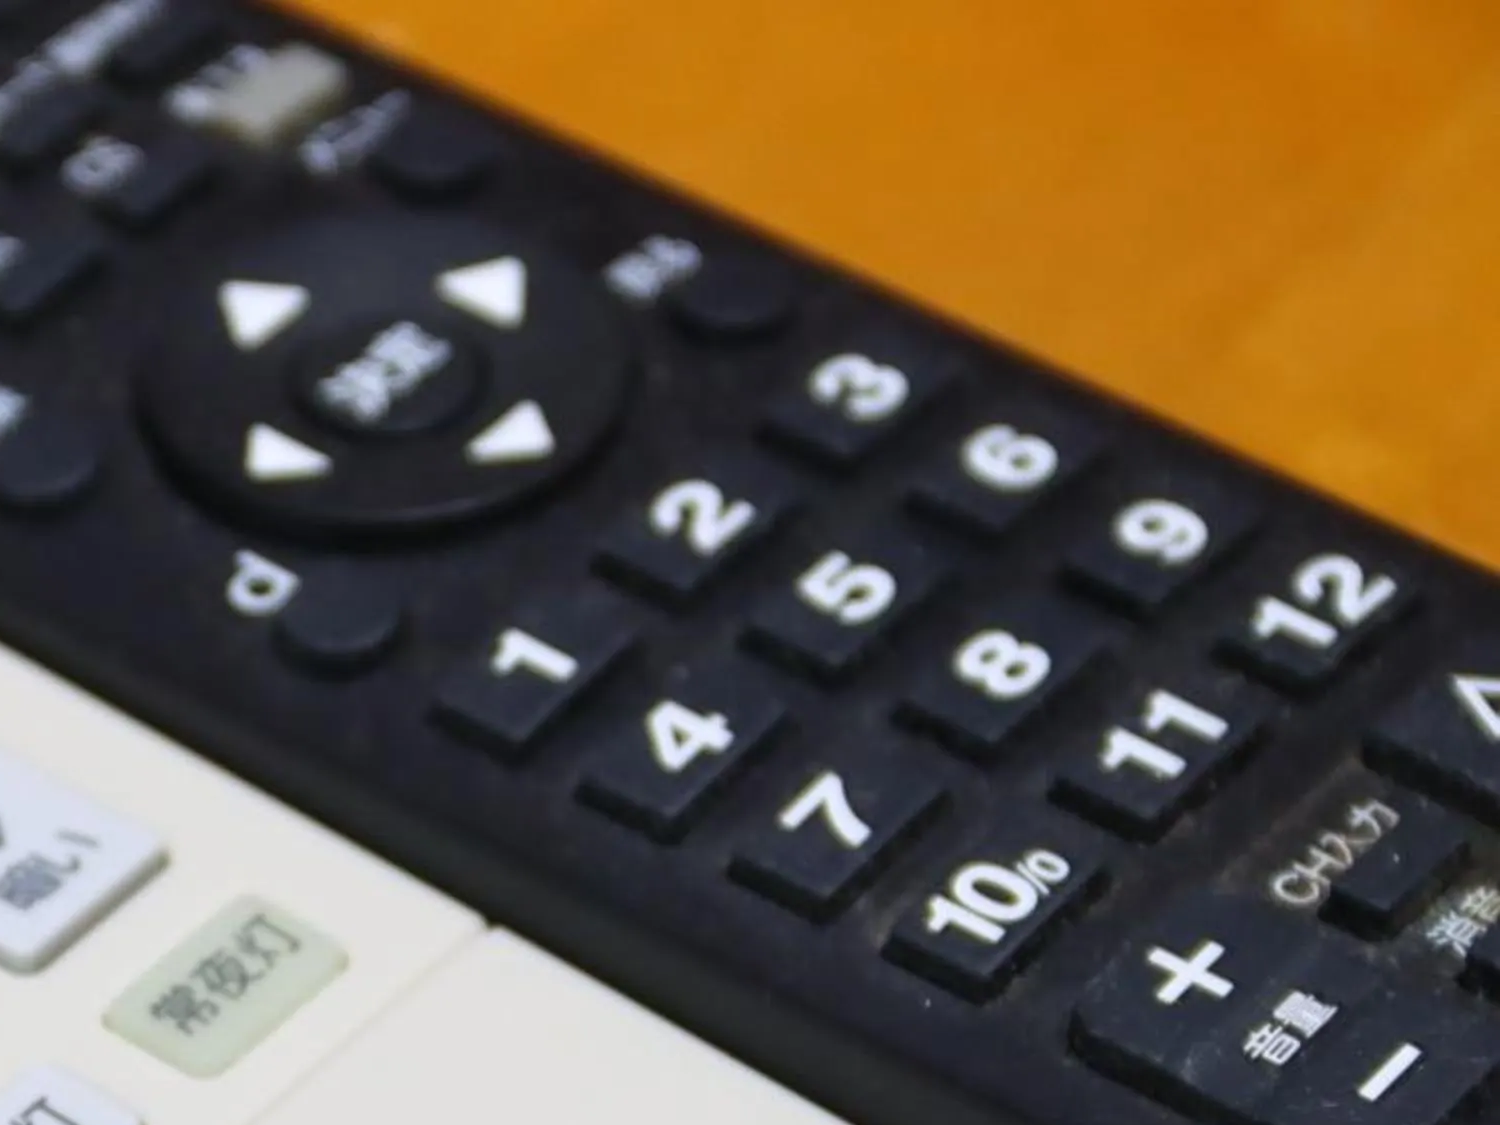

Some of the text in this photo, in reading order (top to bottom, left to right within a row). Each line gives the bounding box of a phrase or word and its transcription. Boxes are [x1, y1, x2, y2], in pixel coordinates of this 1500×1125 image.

[808, 353, 909, 421] 3
[962, 418, 1058, 492] 6
[651, 479, 756, 556] 2
[1112, 498, 1210, 563] 9
[227, 549, 299, 615] d
[796, 551, 897, 625] 5
[1253, 553, 1397, 650] 12
[490, 627, 579, 683] 1
[953, 628, 1051, 700] 8
[646, 700, 735, 772] 4
[1101, 688, 1230, 781] 11
[777, 770, 872, 848] 7
[149, 912, 302, 1036] 常夜灯
[1243, 990, 1338, 1064] 音量
